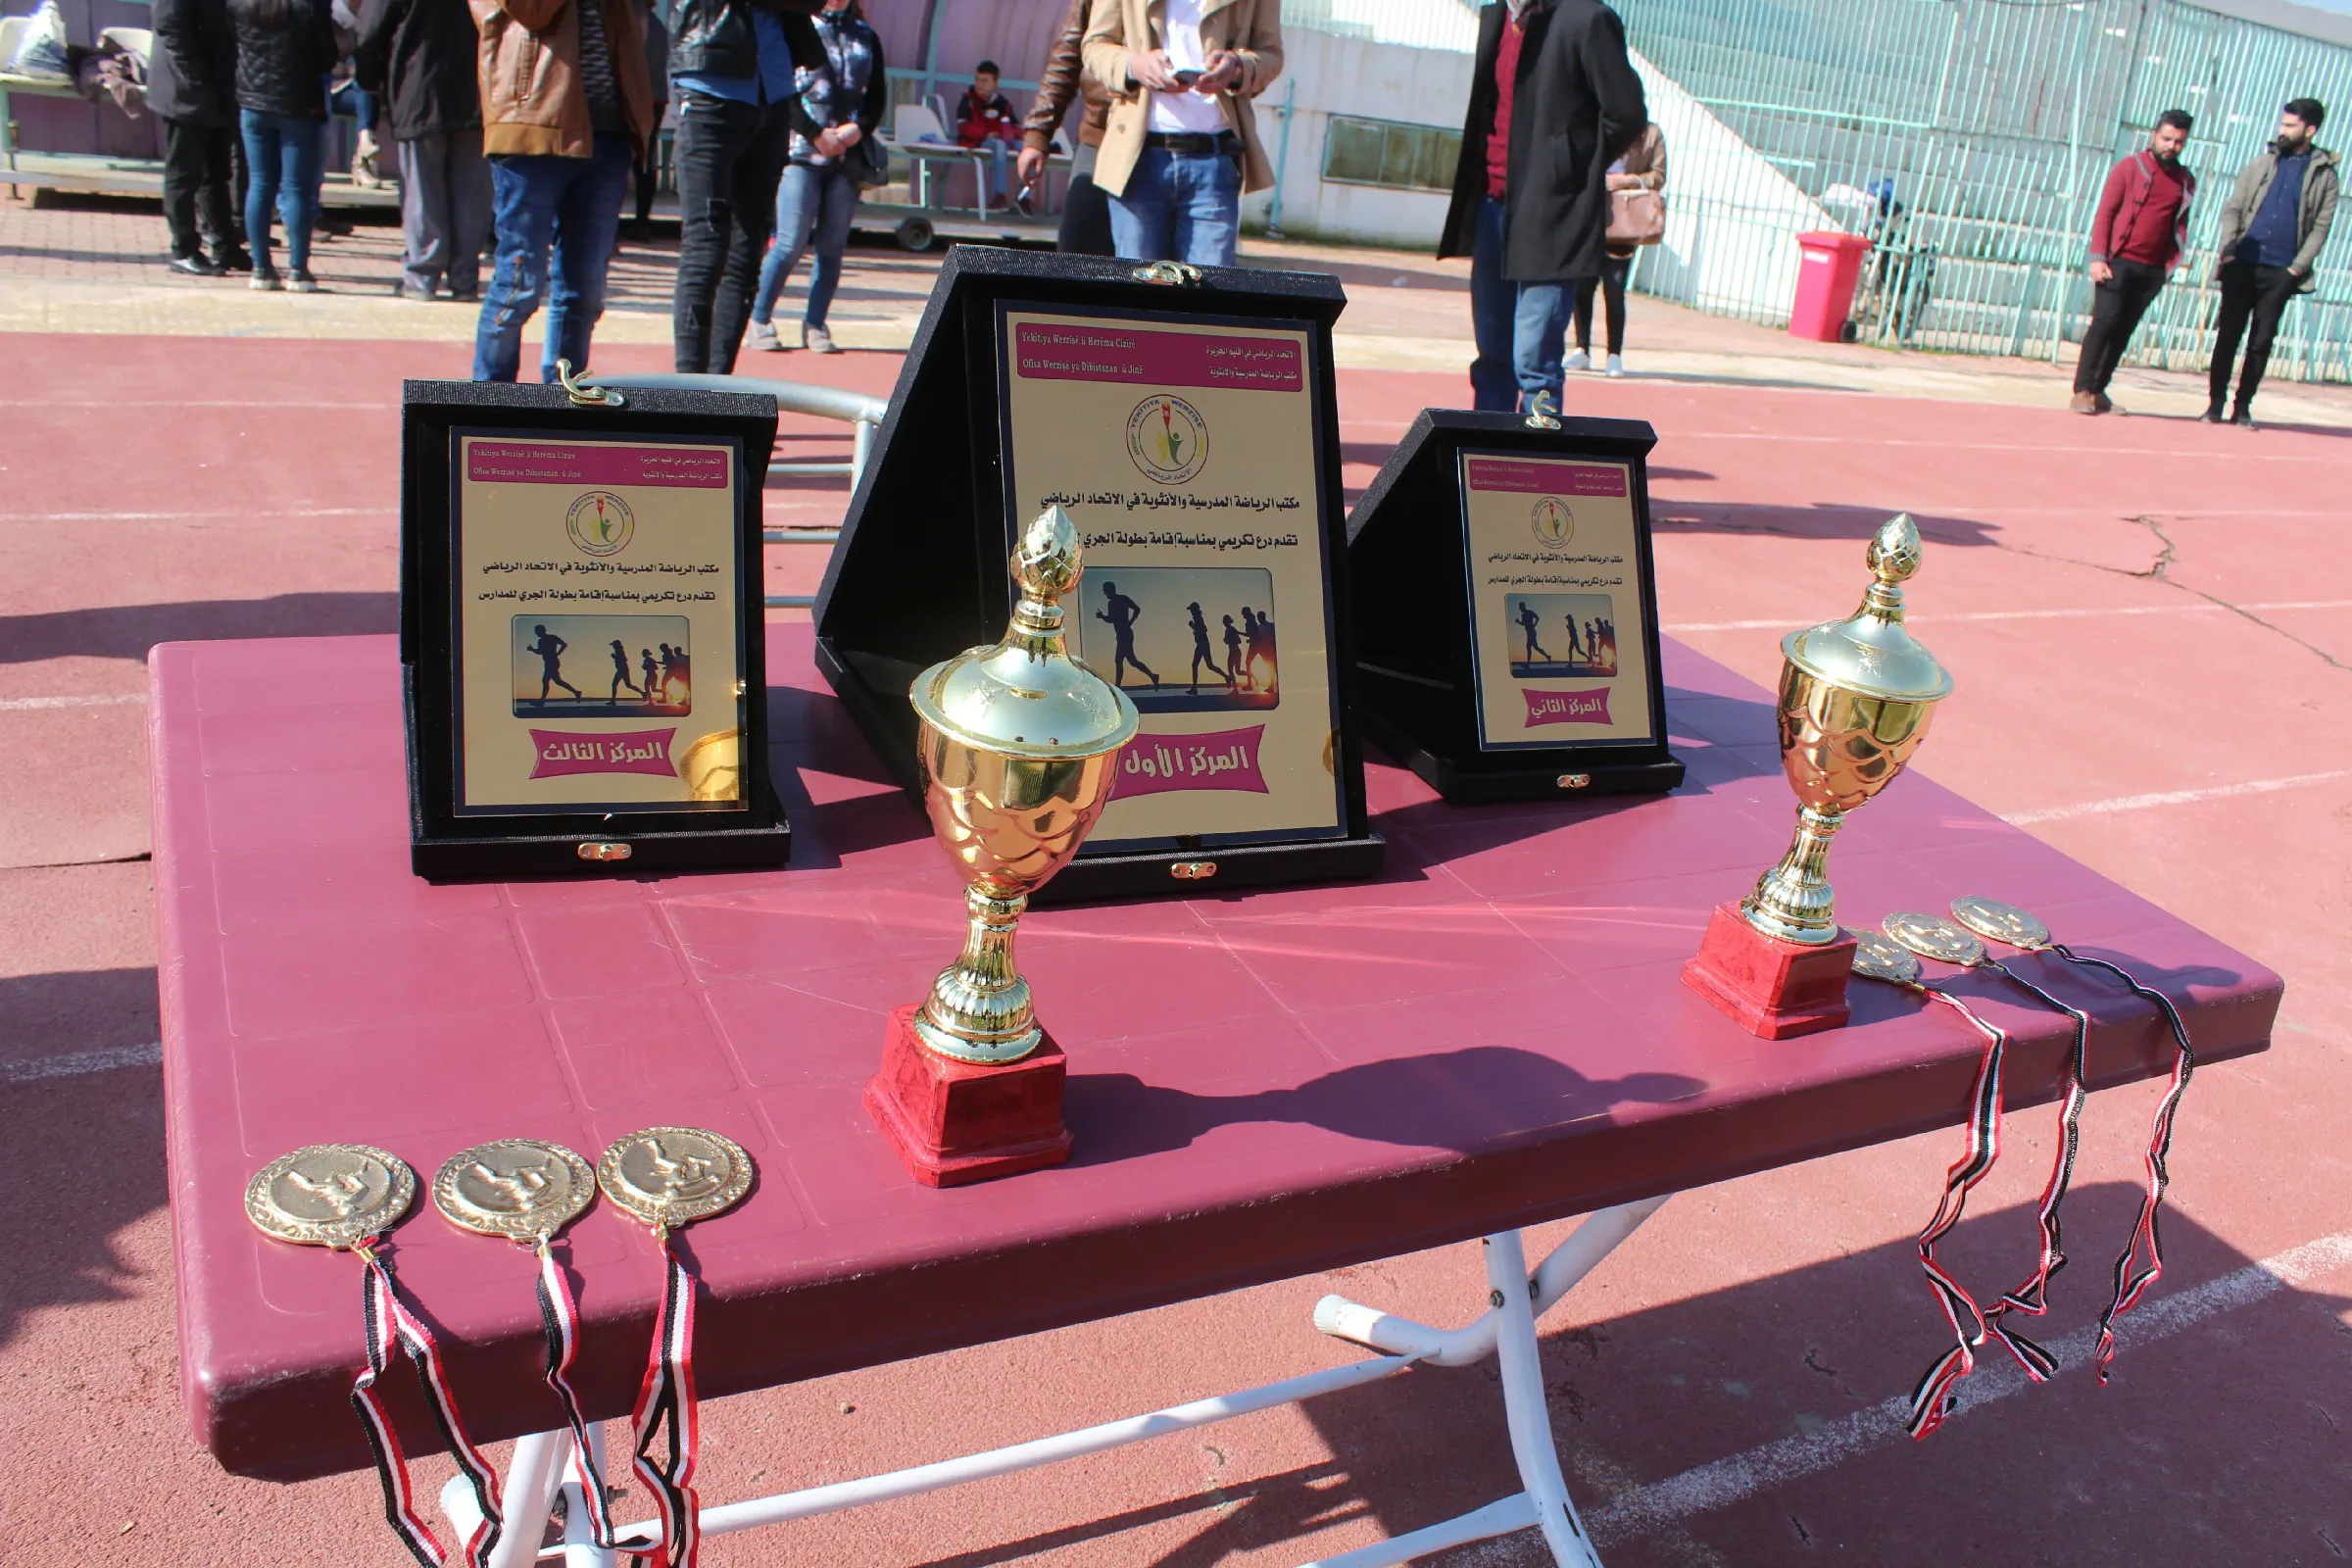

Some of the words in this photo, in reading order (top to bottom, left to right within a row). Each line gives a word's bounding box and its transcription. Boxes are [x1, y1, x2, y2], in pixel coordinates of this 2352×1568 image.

[1244, 347, 1252, 360] في
[1071, 363, 1079, 372] ya
[1041, 492, 1085, 509] الرياضي
[1088, 492, 1124, 505] الاتحاد
[1126, 492, 1141, 511] في
[1189, 494, 1233, 510] المدرسية
[1235, 495, 1275, 512] الرياضة
[1276, 497, 1300, 512] مكتب
[1084, 532, 1114, 548] الجري
[1116, 531, 1148, 548] بطولة
[1218, 533, 1255, 551] تكريمي
[1256, 536, 1273, 549] درع
[1274, 533, 1298, 549] تقدم
[1489, 553, 1510, 563] الرياضي
[1532, 553, 1540, 564] في
[482, 562, 522, 574] الرياضي
[524, 562, 559, 570] الاتحاد
[560, 562, 572, 575] في
[616, 563, 657, 574] المدرسية
[659, 563, 695, 575] الرياضة
[697, 564, 719, 575] مكتب
[478, 590, 516, 600] للمدارس
[518, 590, 547, 602] الجري
[549, 589, 577, 601] بطولة
[642, 591, 675, 604] تكريمي
[676, 593, 692, 602] درع
[693, 591, 715, 602] تقدم
[1531, 698, 1567, 719] الثاني
[1569, 698, 1602, 715] المركز
[542, 742, 605, 760] الثالث
[610, 742, 663, 763] المركز
[1124, 743, 1185, 778] الأول
[1189, 745, 1250, 776] المركز
